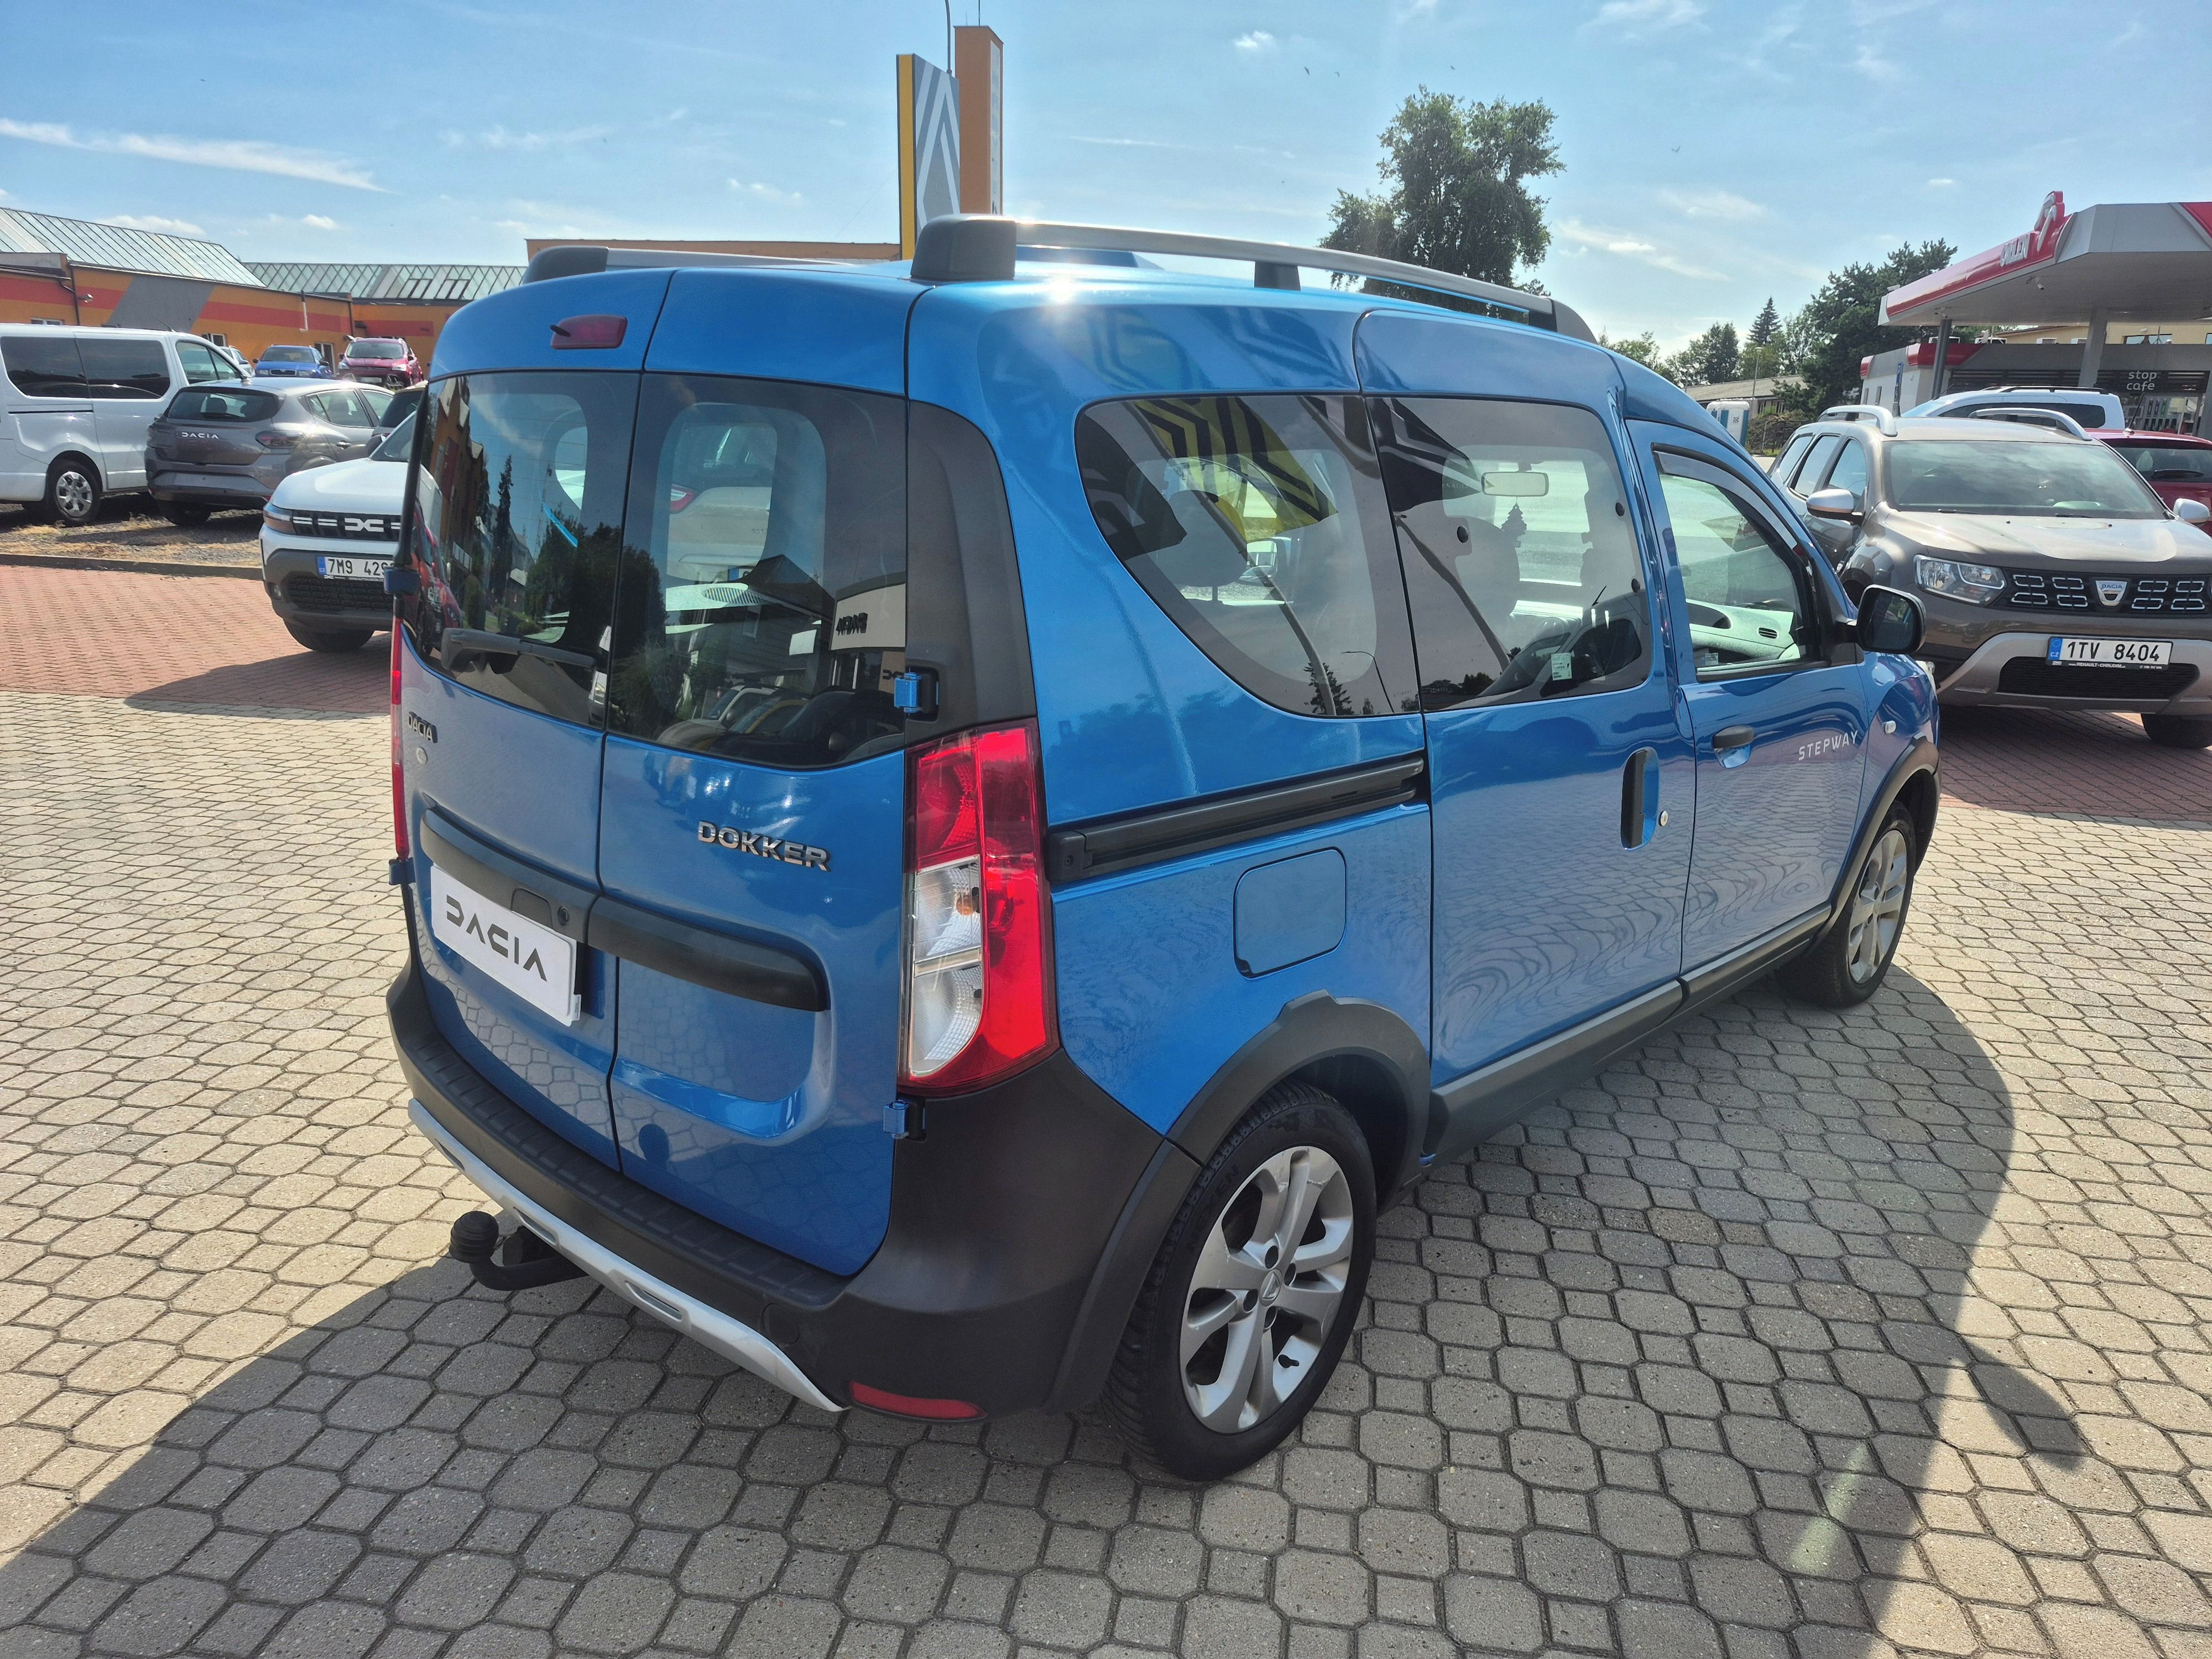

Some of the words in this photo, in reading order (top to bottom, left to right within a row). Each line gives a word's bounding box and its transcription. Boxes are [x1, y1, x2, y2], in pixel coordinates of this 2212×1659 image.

[2126, 381, 2155, 392] cafe
[2127, 370, 2157, 382] stop
[328, 559, 353, 574] 7M9
[364, 561, 394, 577] 429
[2067, 641, 2100, 659] 1TV
[2114, 644, 2160, 662] 8404
[408, 712, 436, 743] DACIA
[1798, 730, 1858, 761] STEPWAY
[698, 820, 831, 872] DOKKER
[446, 894, 547, 982] DACIA
